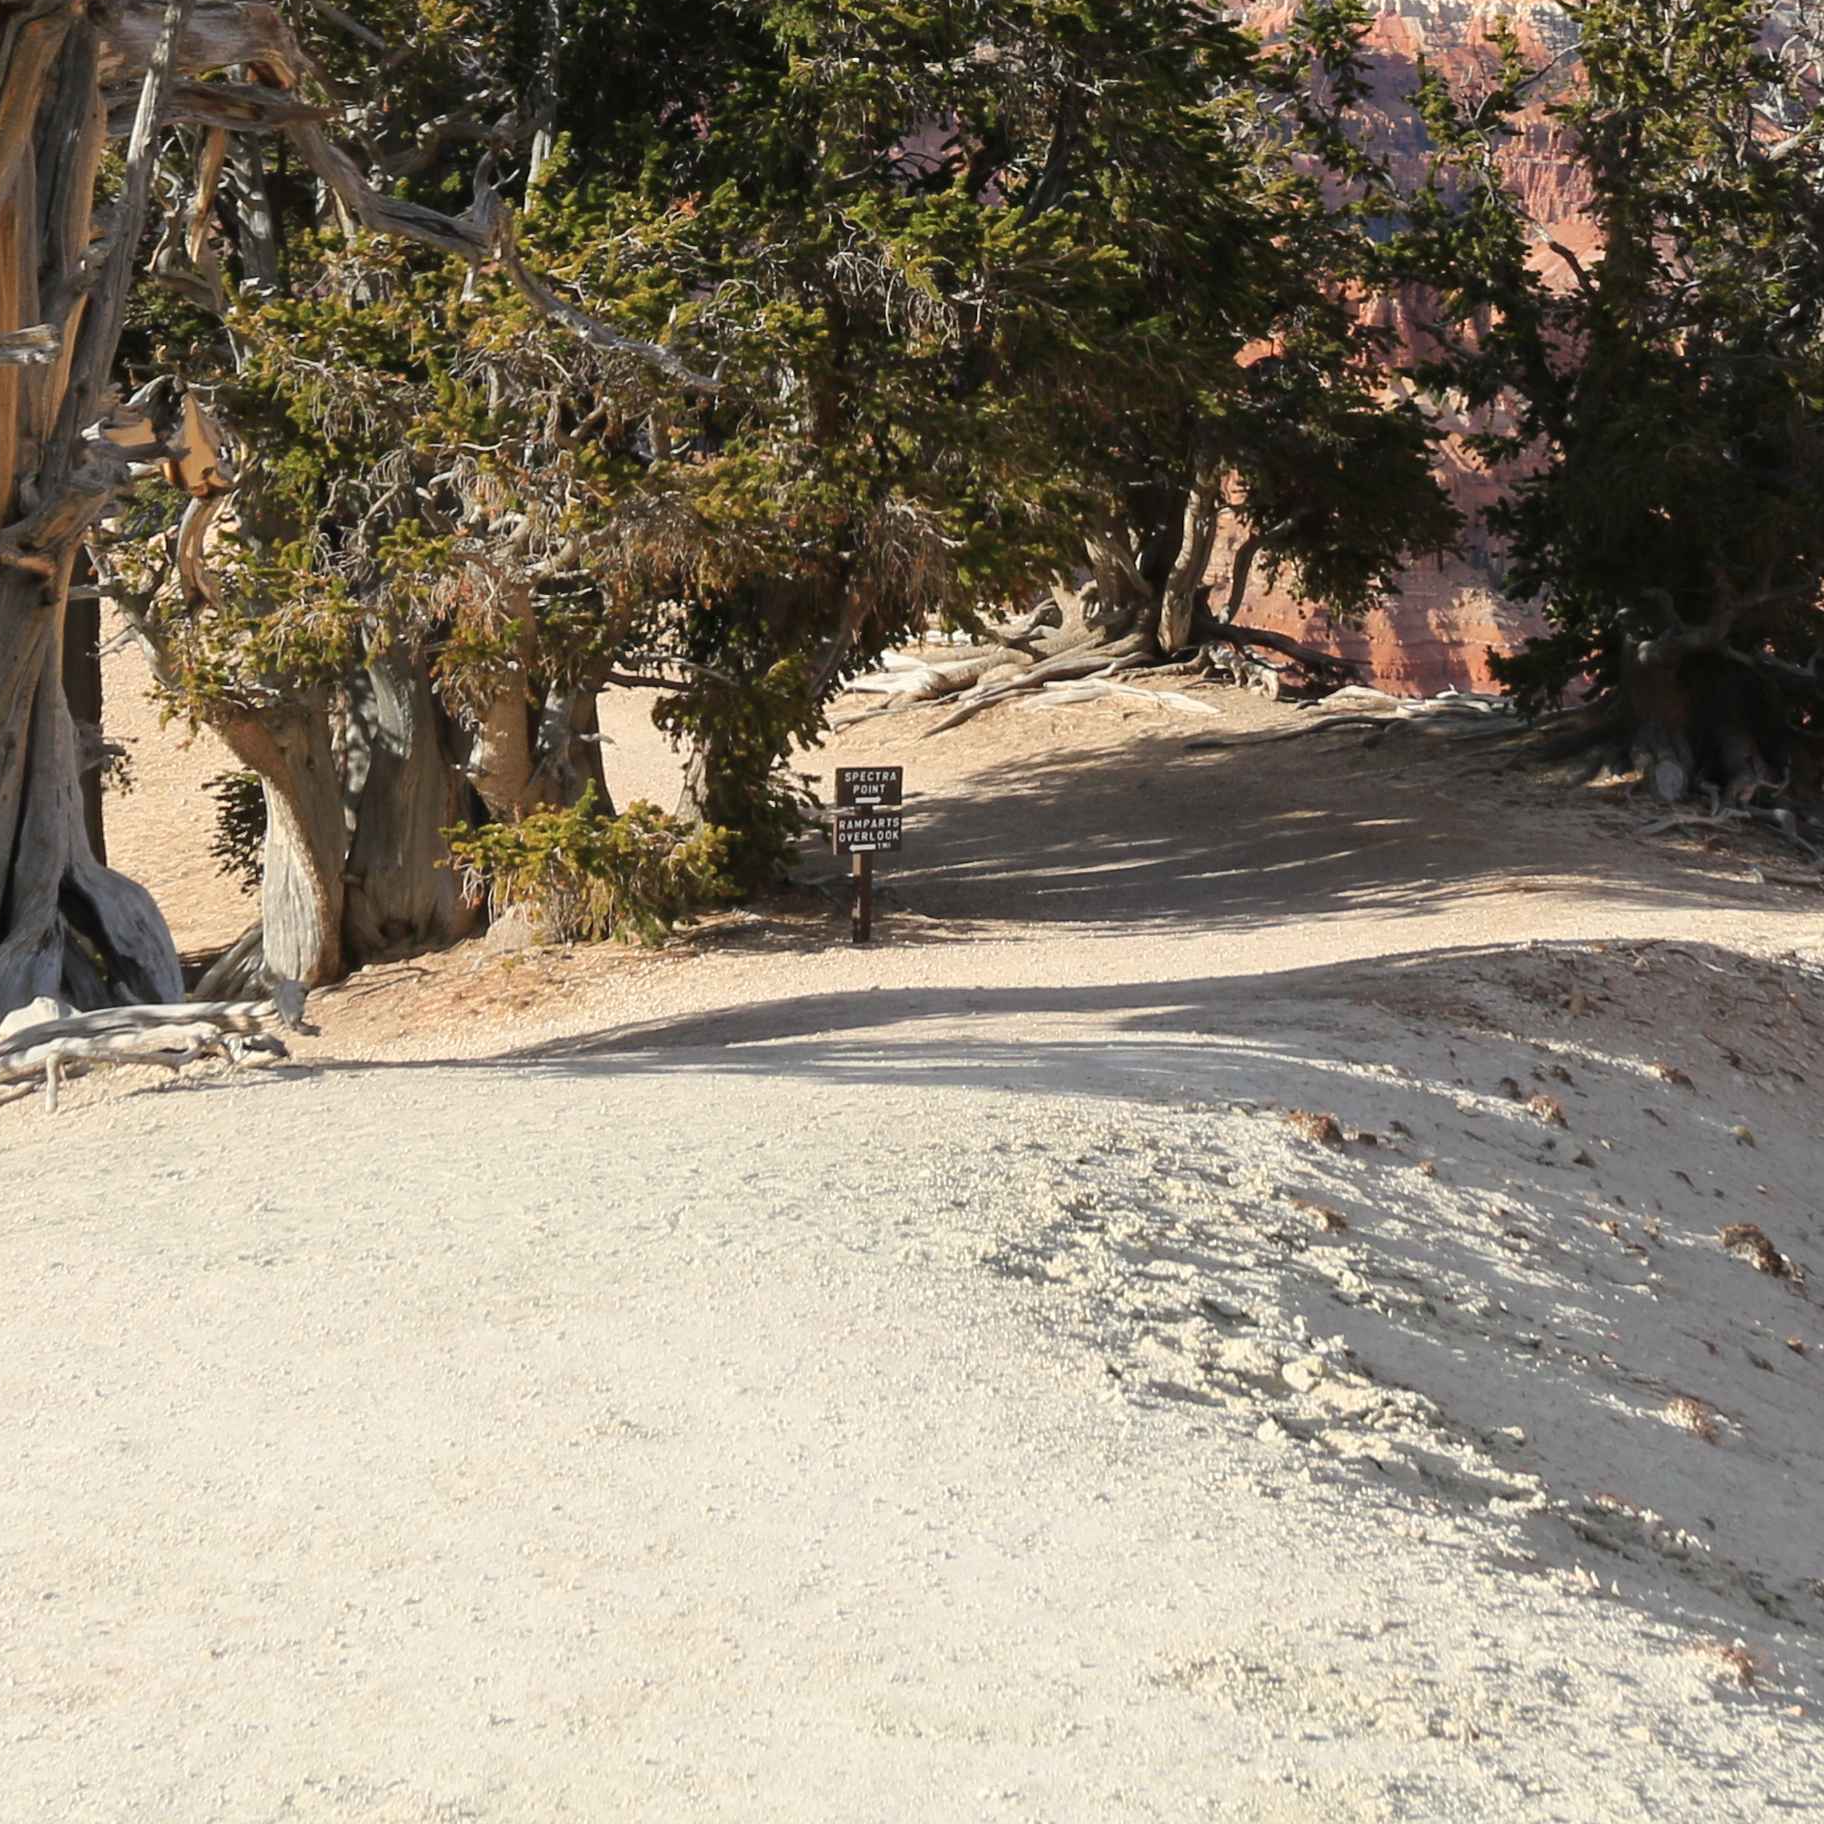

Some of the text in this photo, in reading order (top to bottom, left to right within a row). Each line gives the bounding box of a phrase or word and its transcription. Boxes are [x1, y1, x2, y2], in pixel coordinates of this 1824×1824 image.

[845, 771, 896, 782] SPECTRA
[853, 784, 885, 794] POINT
[839, 817, 900, 829] RAMPARTS
[839, 830, 899, 842] OVERLOOK
